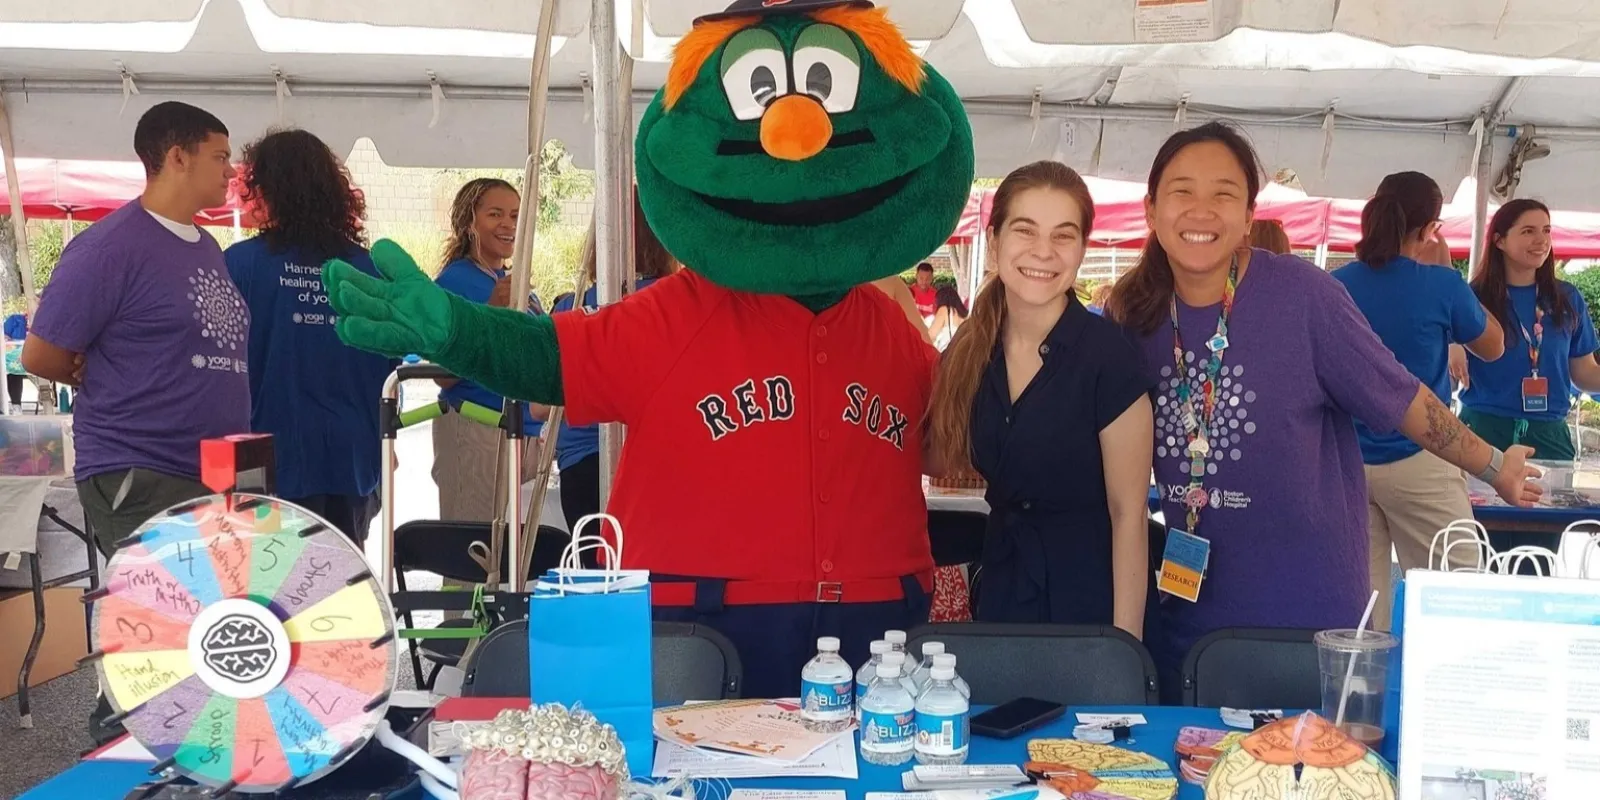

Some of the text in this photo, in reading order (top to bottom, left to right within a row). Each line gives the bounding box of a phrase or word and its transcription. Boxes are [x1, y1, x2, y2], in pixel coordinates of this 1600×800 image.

[279, 275, 320, 292] healing
[298, 291, 310, 302] of
[303, 313, 324, 322] yoga
[207, 355, 231, 367] yoga
[696, 375, 908, 451] RED SOX
[176, 542, 195, 577] 4
[259, 538, 286, 572] 5
[119, 569, 162, 590] Truth
[284, 557, 332, 606] Stroop
[1162, 570, 1198, 589] RESEARCH
[116, 617, 153, 644] 3
[310, 615, 352, 632] 6
[114, 658, 160, 680] Hand
[128, 670, 181, 697] illusion
[299, 686, 341, 715] 7
[163, 701, 187, 728] 2
[199, 709, 230, 764] Stroop
[251, 738, 265, 767] 1
